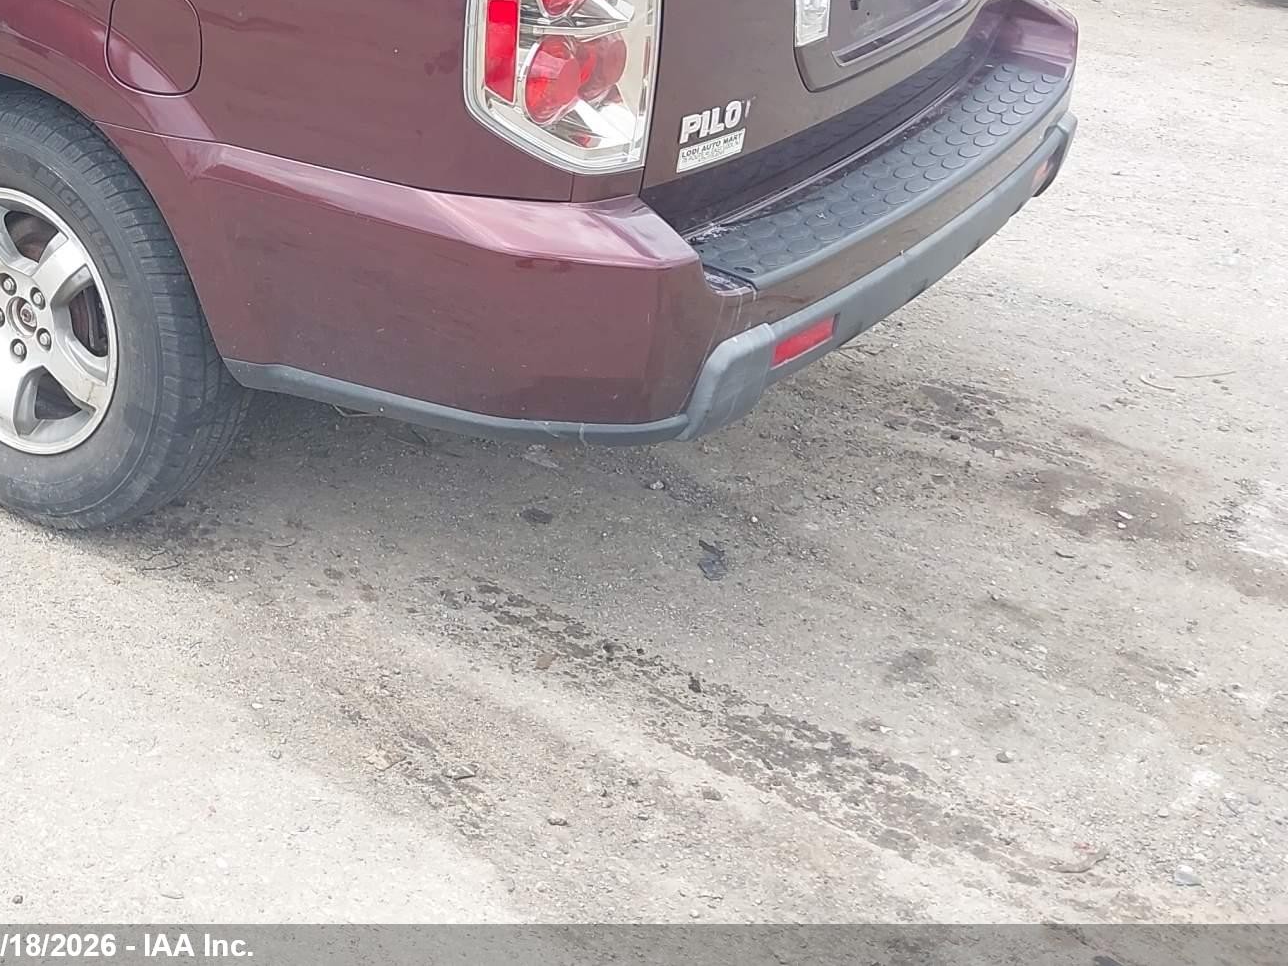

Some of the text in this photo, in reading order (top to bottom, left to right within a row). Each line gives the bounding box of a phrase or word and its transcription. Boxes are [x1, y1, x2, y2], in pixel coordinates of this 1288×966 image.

[682, 146, 700, 158] LODI
[701, 141, 722, 152] AUTO
[723, 133, 743, 144] MART
